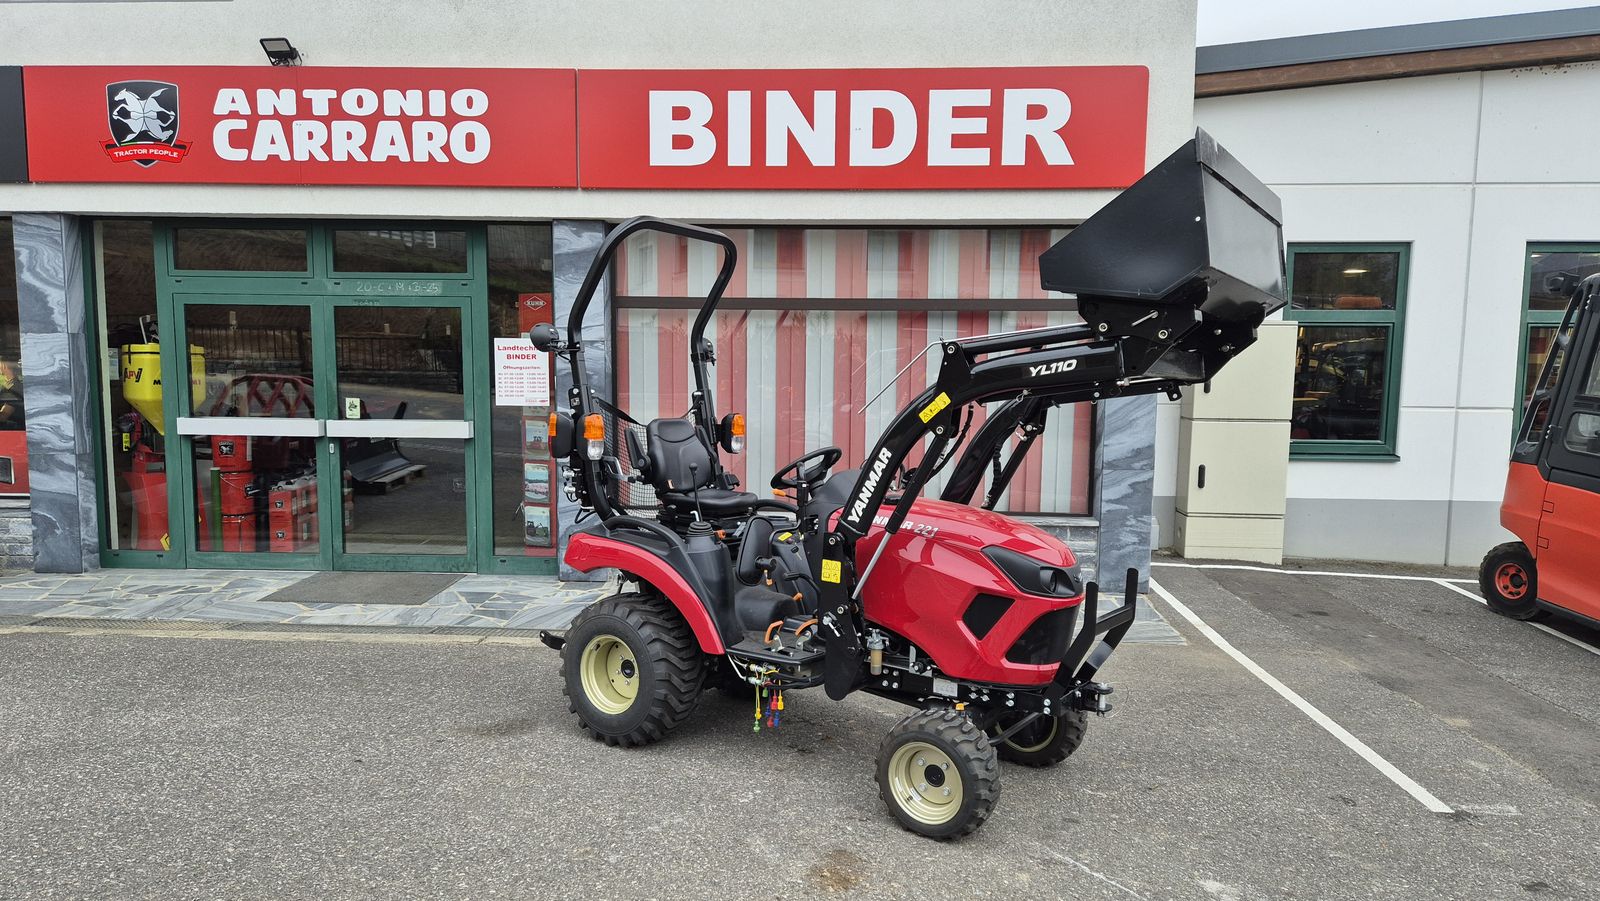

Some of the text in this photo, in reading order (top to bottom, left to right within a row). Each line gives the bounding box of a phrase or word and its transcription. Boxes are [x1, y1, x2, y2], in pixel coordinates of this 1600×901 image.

[213, 88, 489, 116] ANTONIO
[648, 88, 1075, 167] BINDER
[113, 148, 179, 158] TRACTOR PEOPLE
[213, 119, 491, 165] CARRARO
[1029, 359, 1078, 377] YL110
[847, 447, 892, 523] YANMAR
[914, 523, 939, 538] 221
